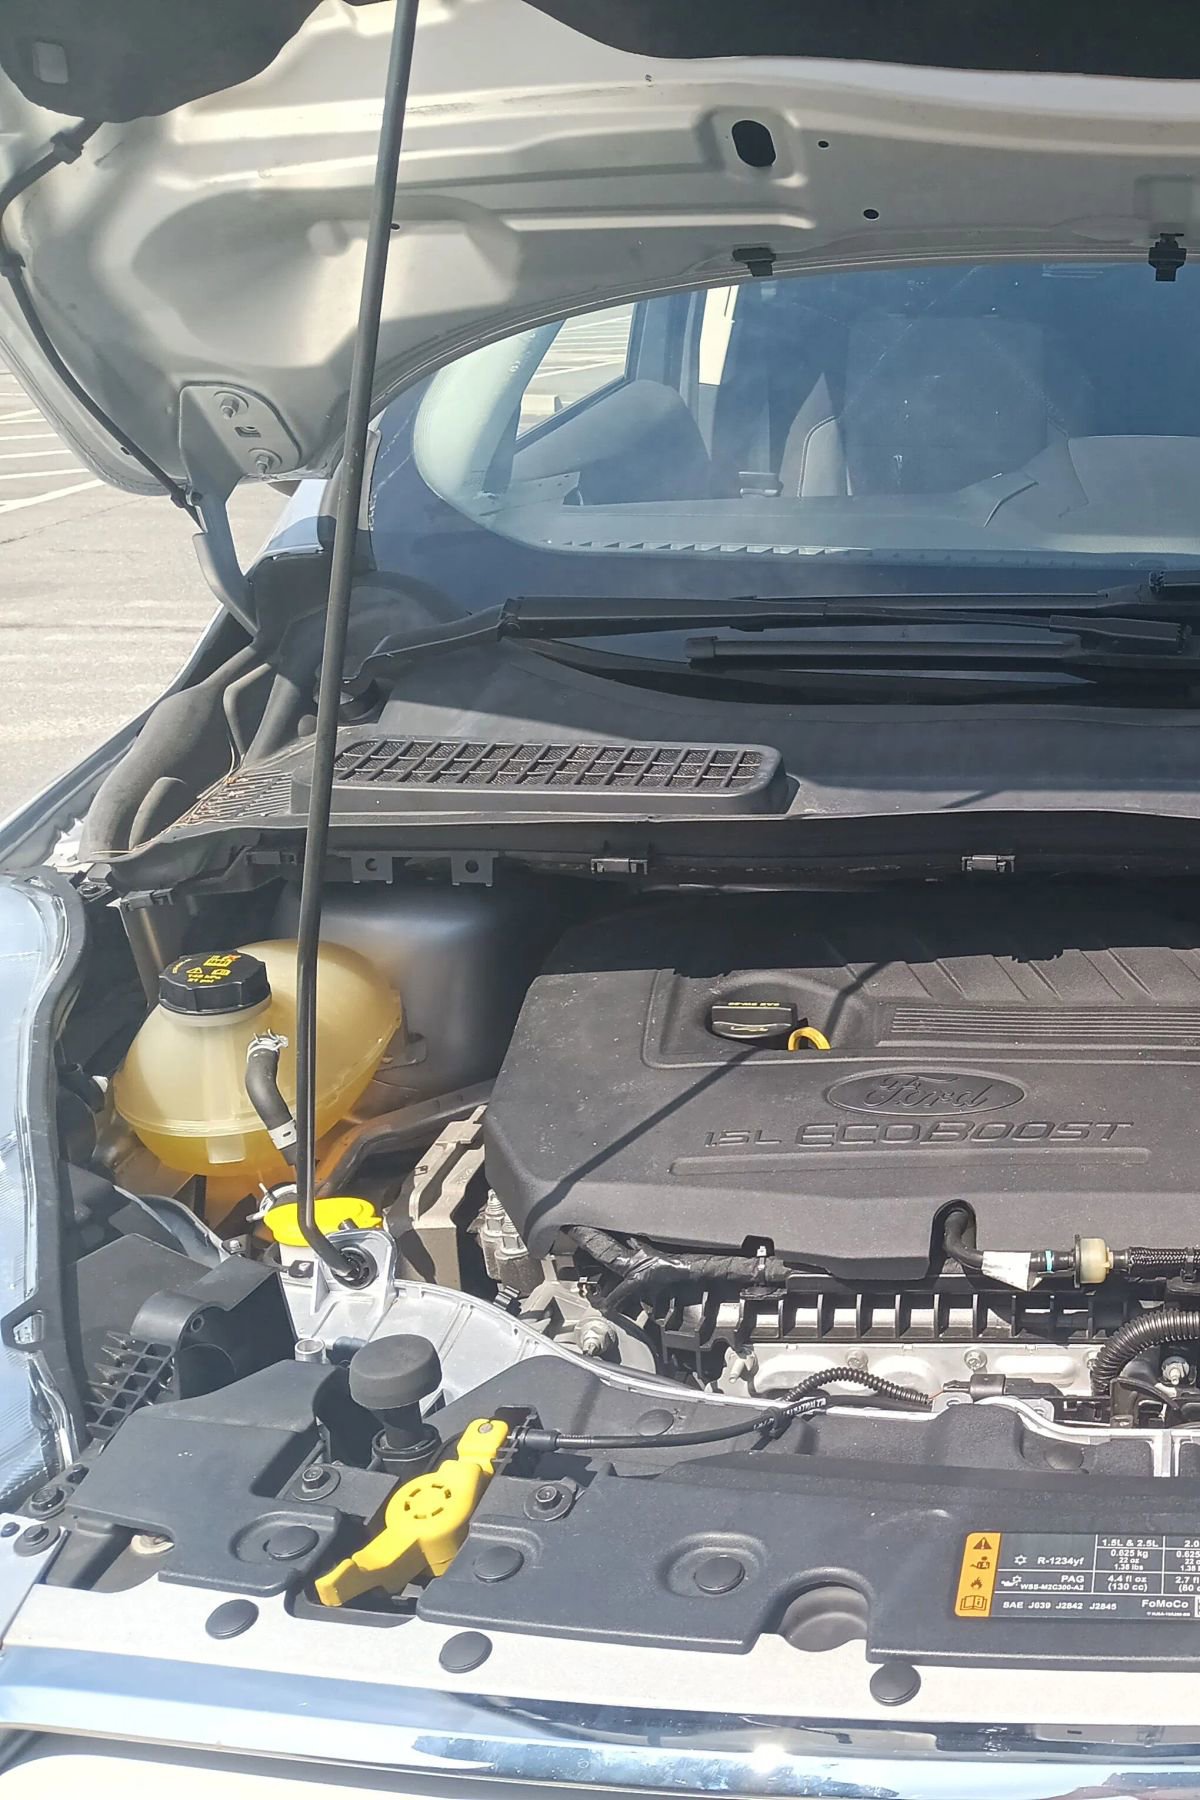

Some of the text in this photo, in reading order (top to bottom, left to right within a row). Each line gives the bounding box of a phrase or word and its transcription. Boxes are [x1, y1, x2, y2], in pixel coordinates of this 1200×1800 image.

[864, 1074, 993, 1108] Ford
[704, 1130, 782, 1148] 1.5L
[1102, 1538, 1159, 1548] 1.5L & 2.5L
[1137, 1549, 1149, 1559] kg
[1037, 1556, 1085, 1567] R-1234yf
[1061, 1574, 1085, 1583] PAG
[1107, 1575, 1123, 1583] 4.4
[1175, 1576, 1191, 1584] 2.7
[1108, 1583, 1148, 1592] (130 cc)
[1003, 1601, 1024, 1609] SAE
[1142, 1599, 1189, 1609] FoMoCo
